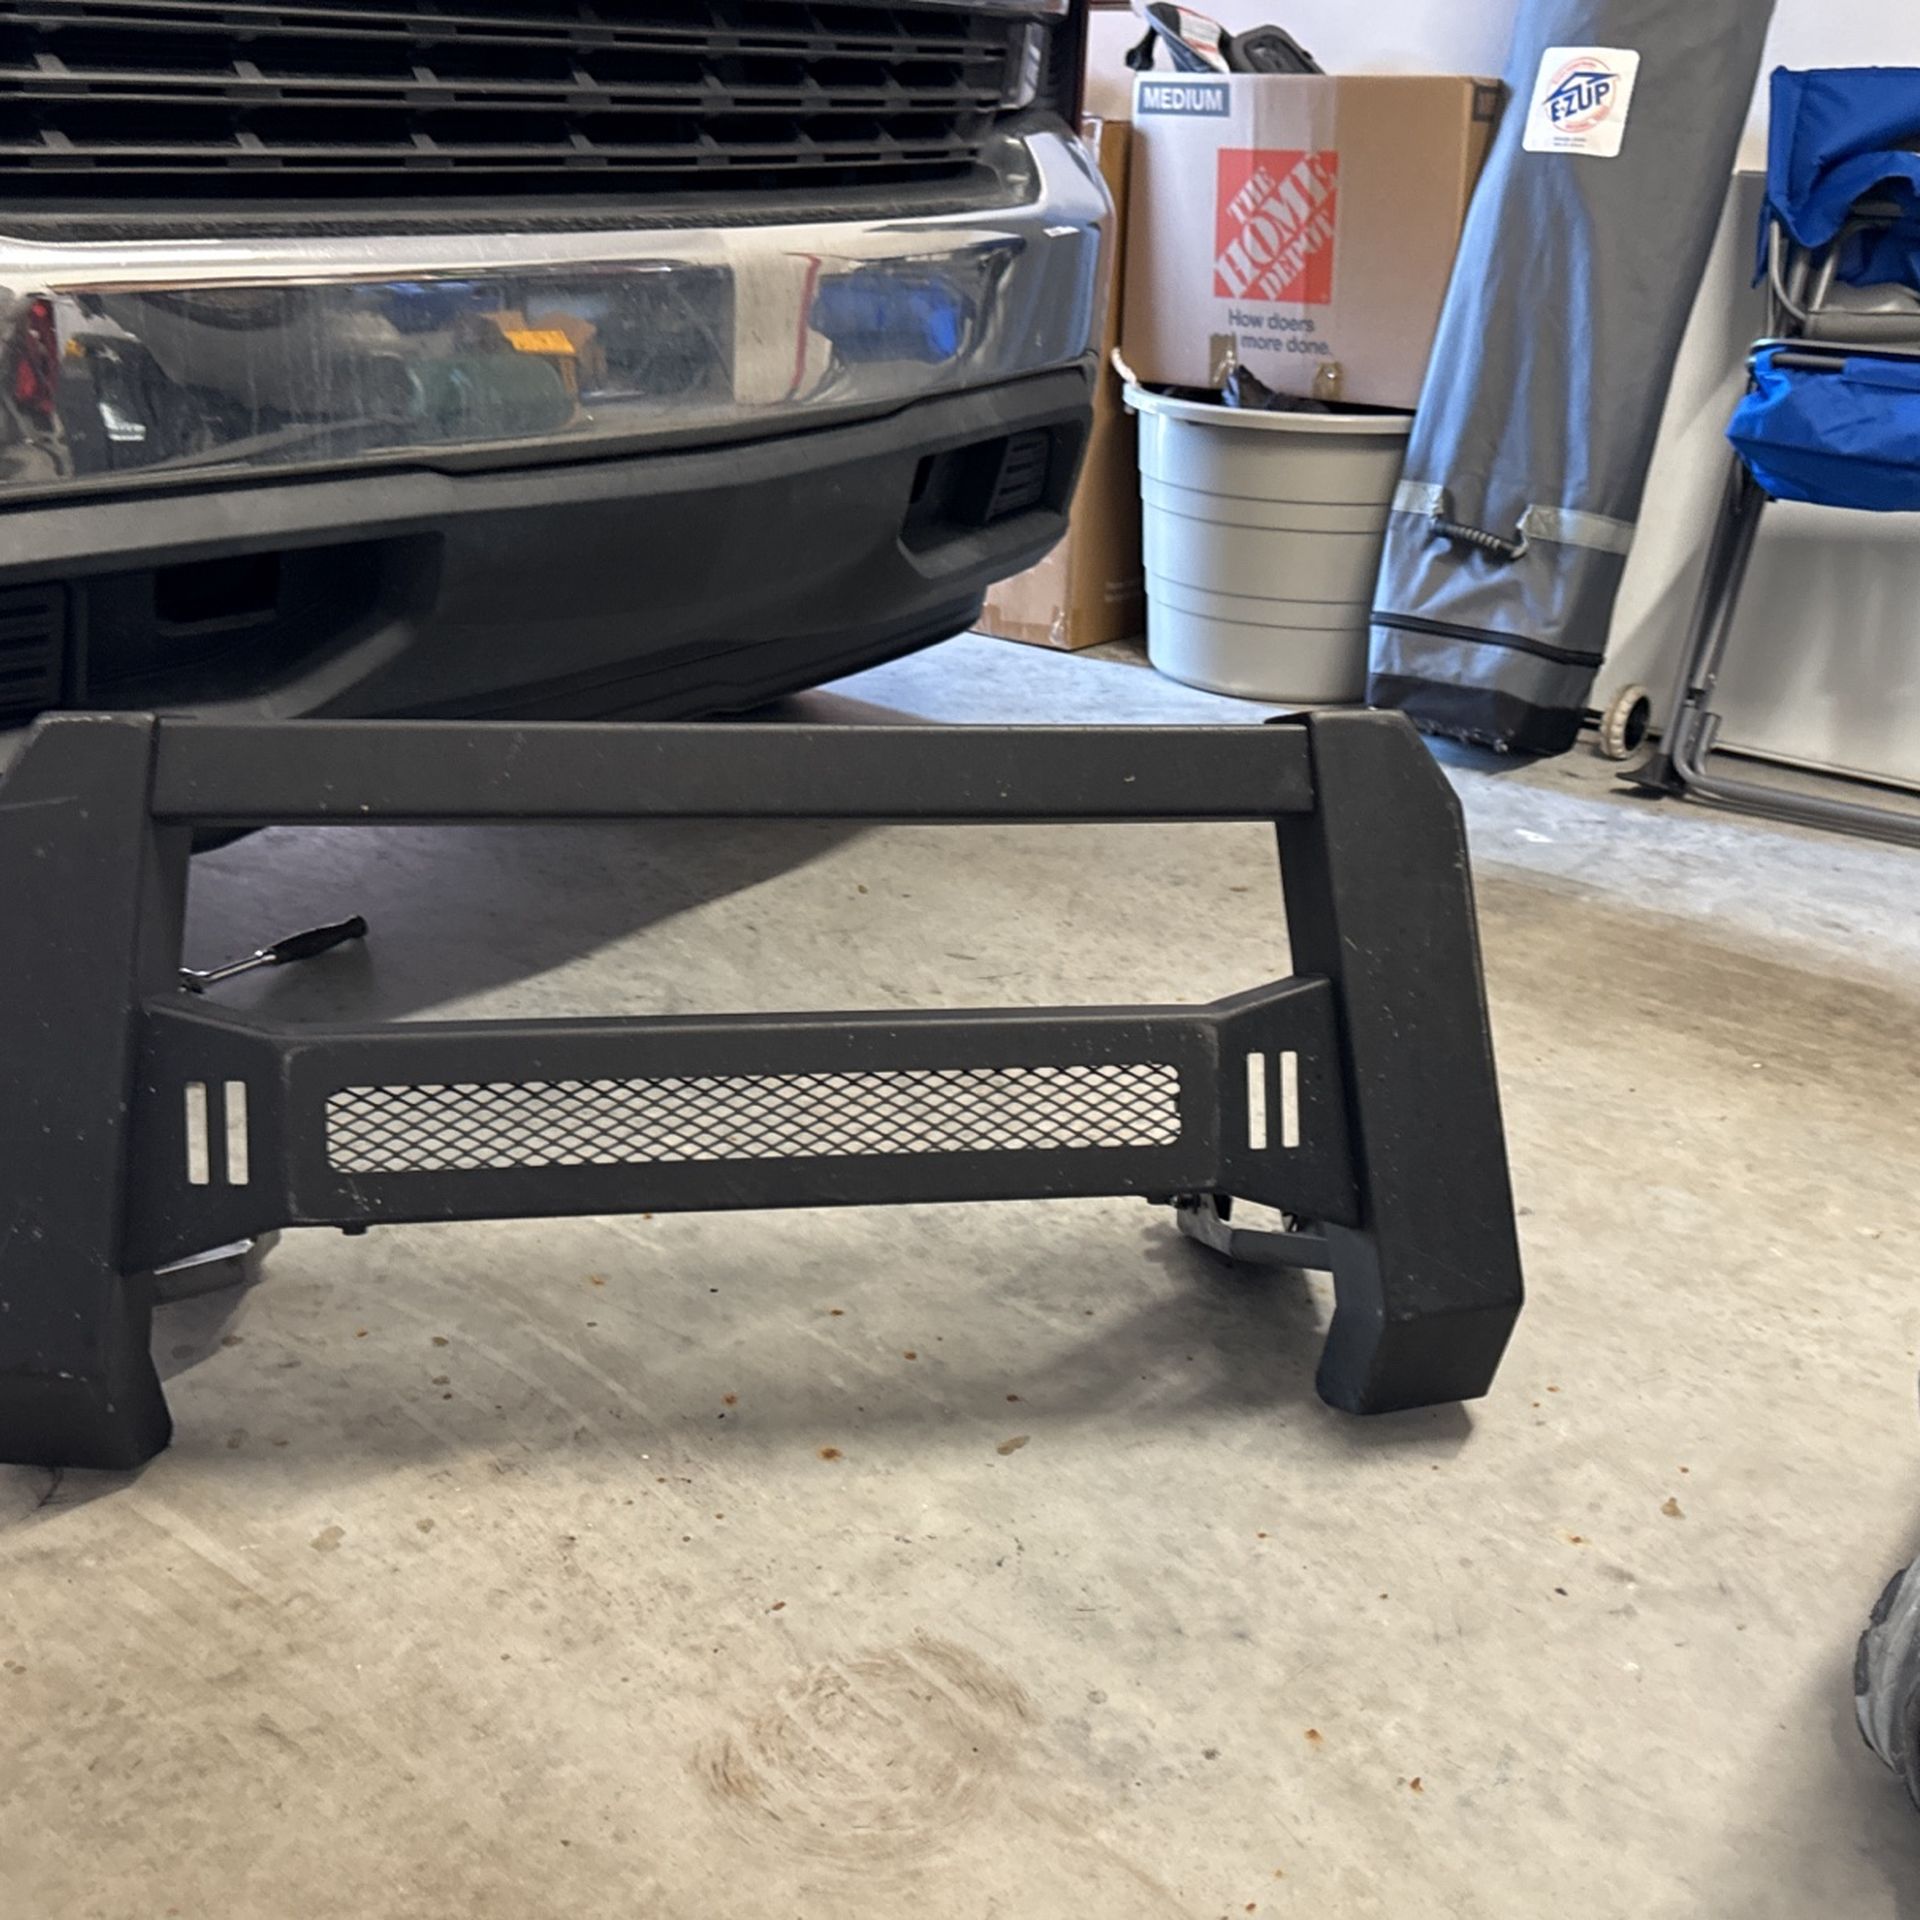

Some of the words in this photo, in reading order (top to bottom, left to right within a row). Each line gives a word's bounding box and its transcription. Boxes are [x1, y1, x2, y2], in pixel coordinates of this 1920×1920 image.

[1142, 85, 1224, 112] MEDIUM
[1226, 165, 1277, 225] THE
[1213, 153, 1338, 299] HOME
[1258, 207, 1335, 301] DEPOT
[1227, 307, 1264, 328] How
[1266, 312, 1315, 333] doers
[1240, 334, 1283, 352] more
